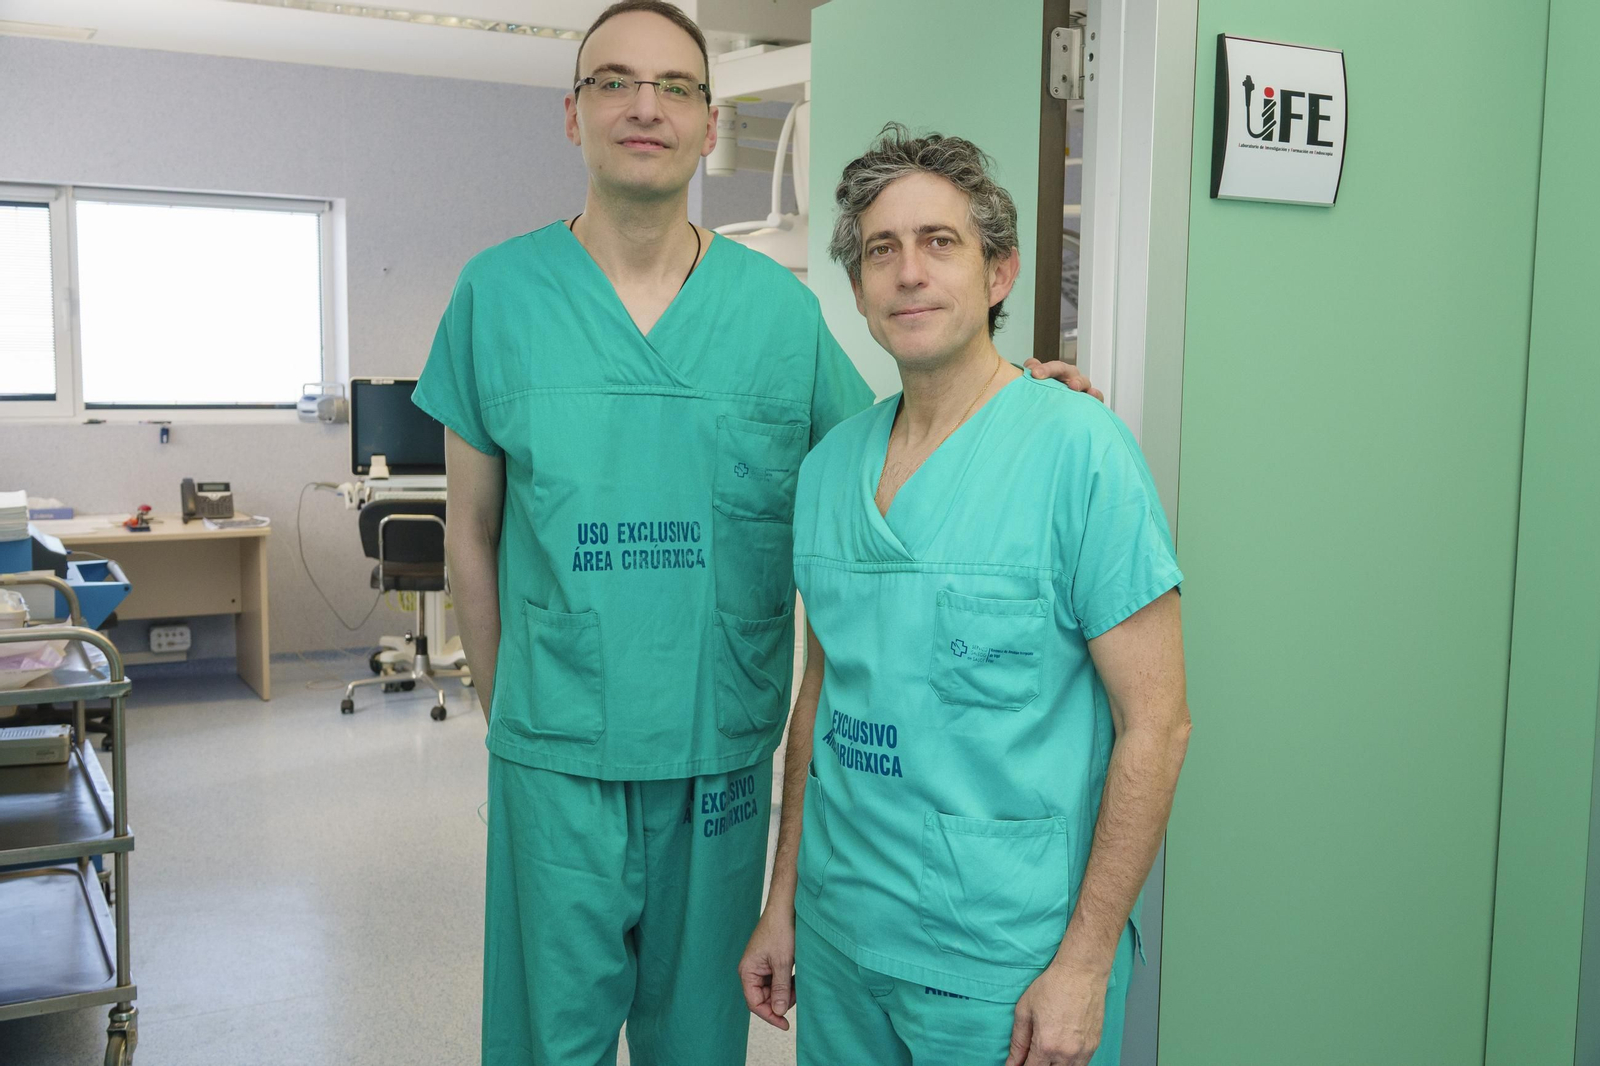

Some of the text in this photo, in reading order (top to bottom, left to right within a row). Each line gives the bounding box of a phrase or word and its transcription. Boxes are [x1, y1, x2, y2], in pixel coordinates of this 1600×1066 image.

[577, 521, 701, 545] USO EXCLUSIVO
[572, 544, 706, 572] ÁREA CIRÚRXICA
[832, 709, 898, 749] EXCLUSIVO
[701, 774, 755, 815] EXCSIVO
